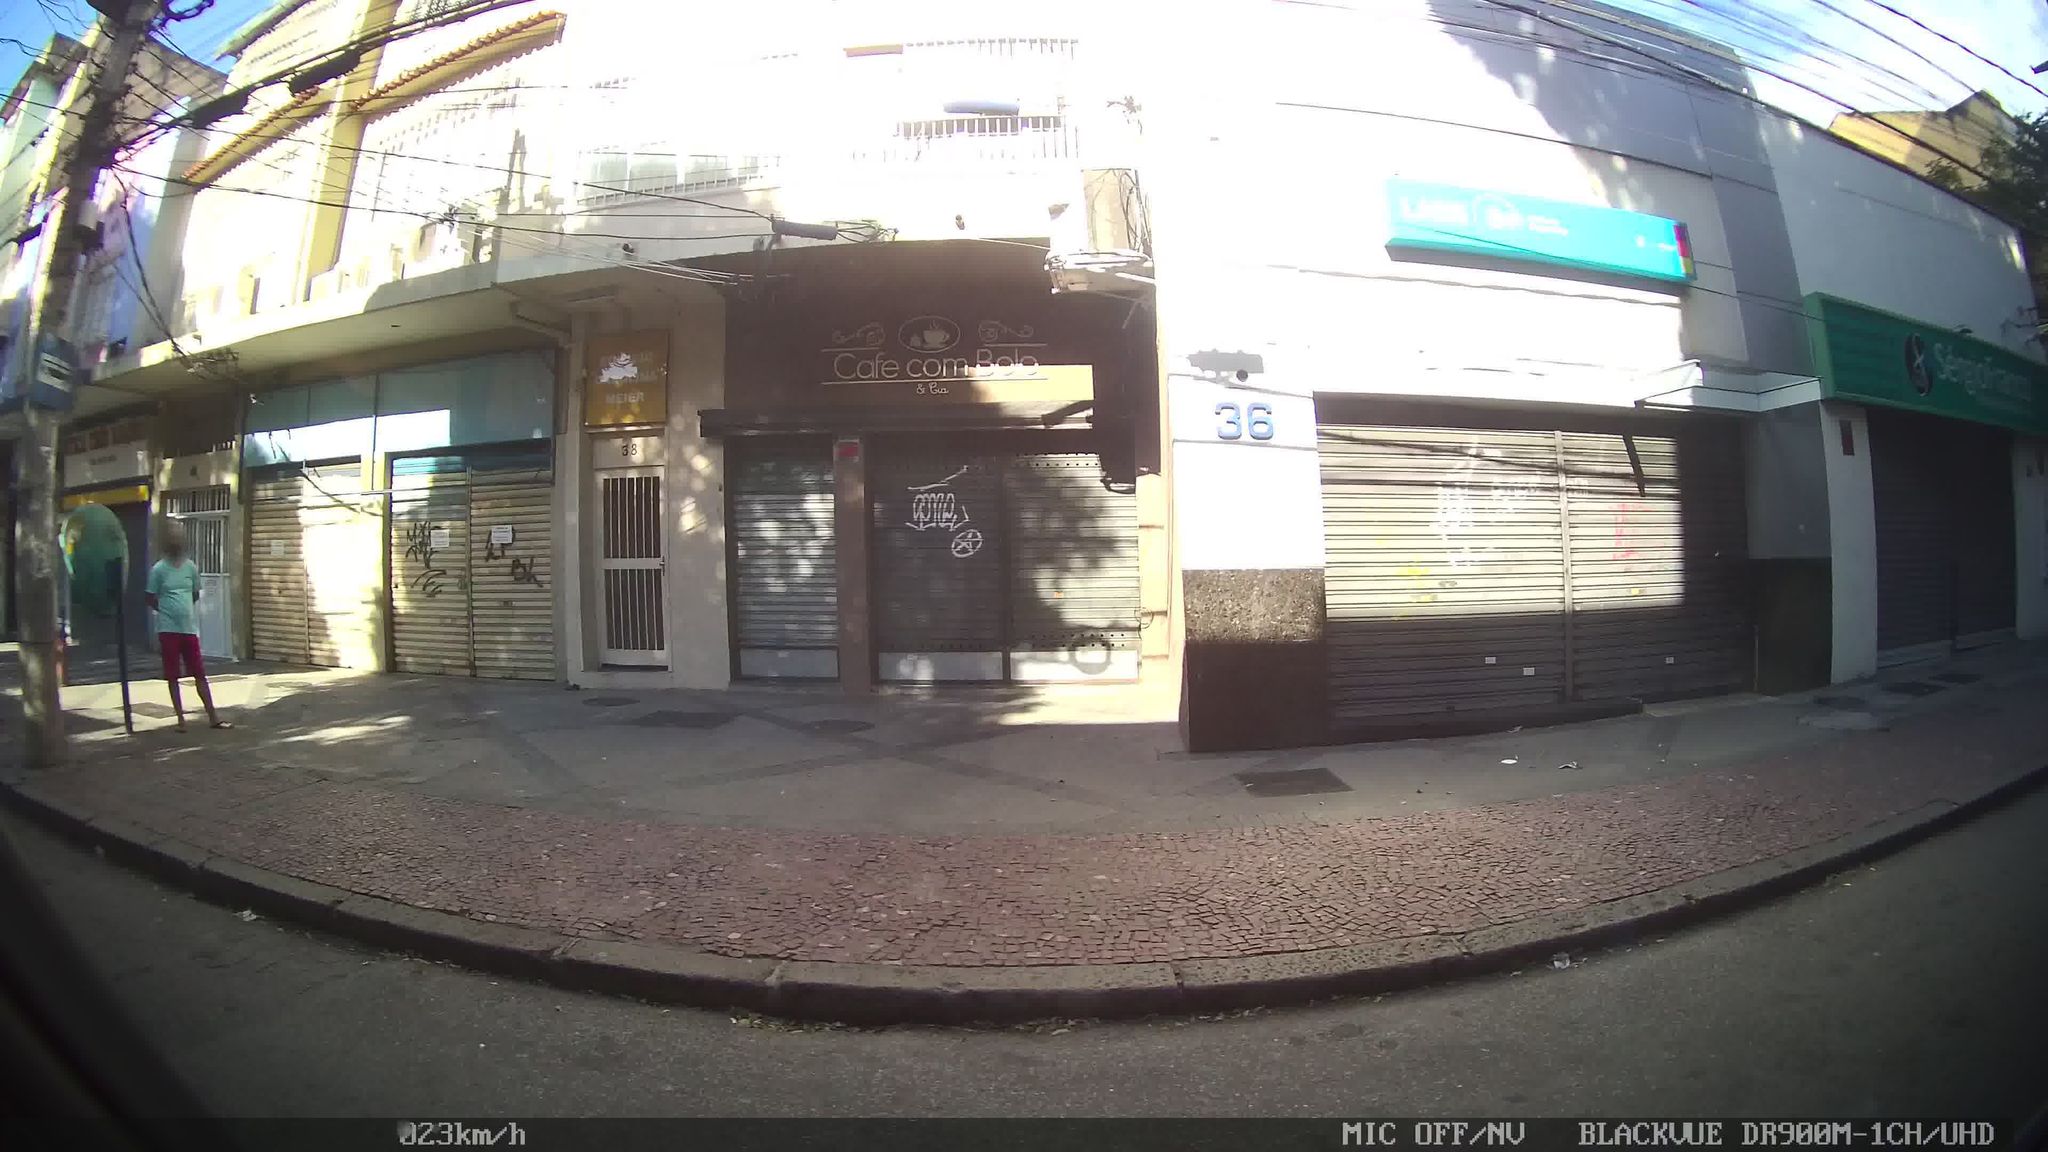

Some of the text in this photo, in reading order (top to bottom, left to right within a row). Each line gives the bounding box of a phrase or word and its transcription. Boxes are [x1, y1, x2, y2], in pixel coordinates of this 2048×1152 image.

[834, 351, 899, 379] Cafe
[906, 358, 969, 377] com
[916, 382, 949, 394] & Cia
[1214, 402, 1274, 440] 36
[621, 443, 637, 456] 38
